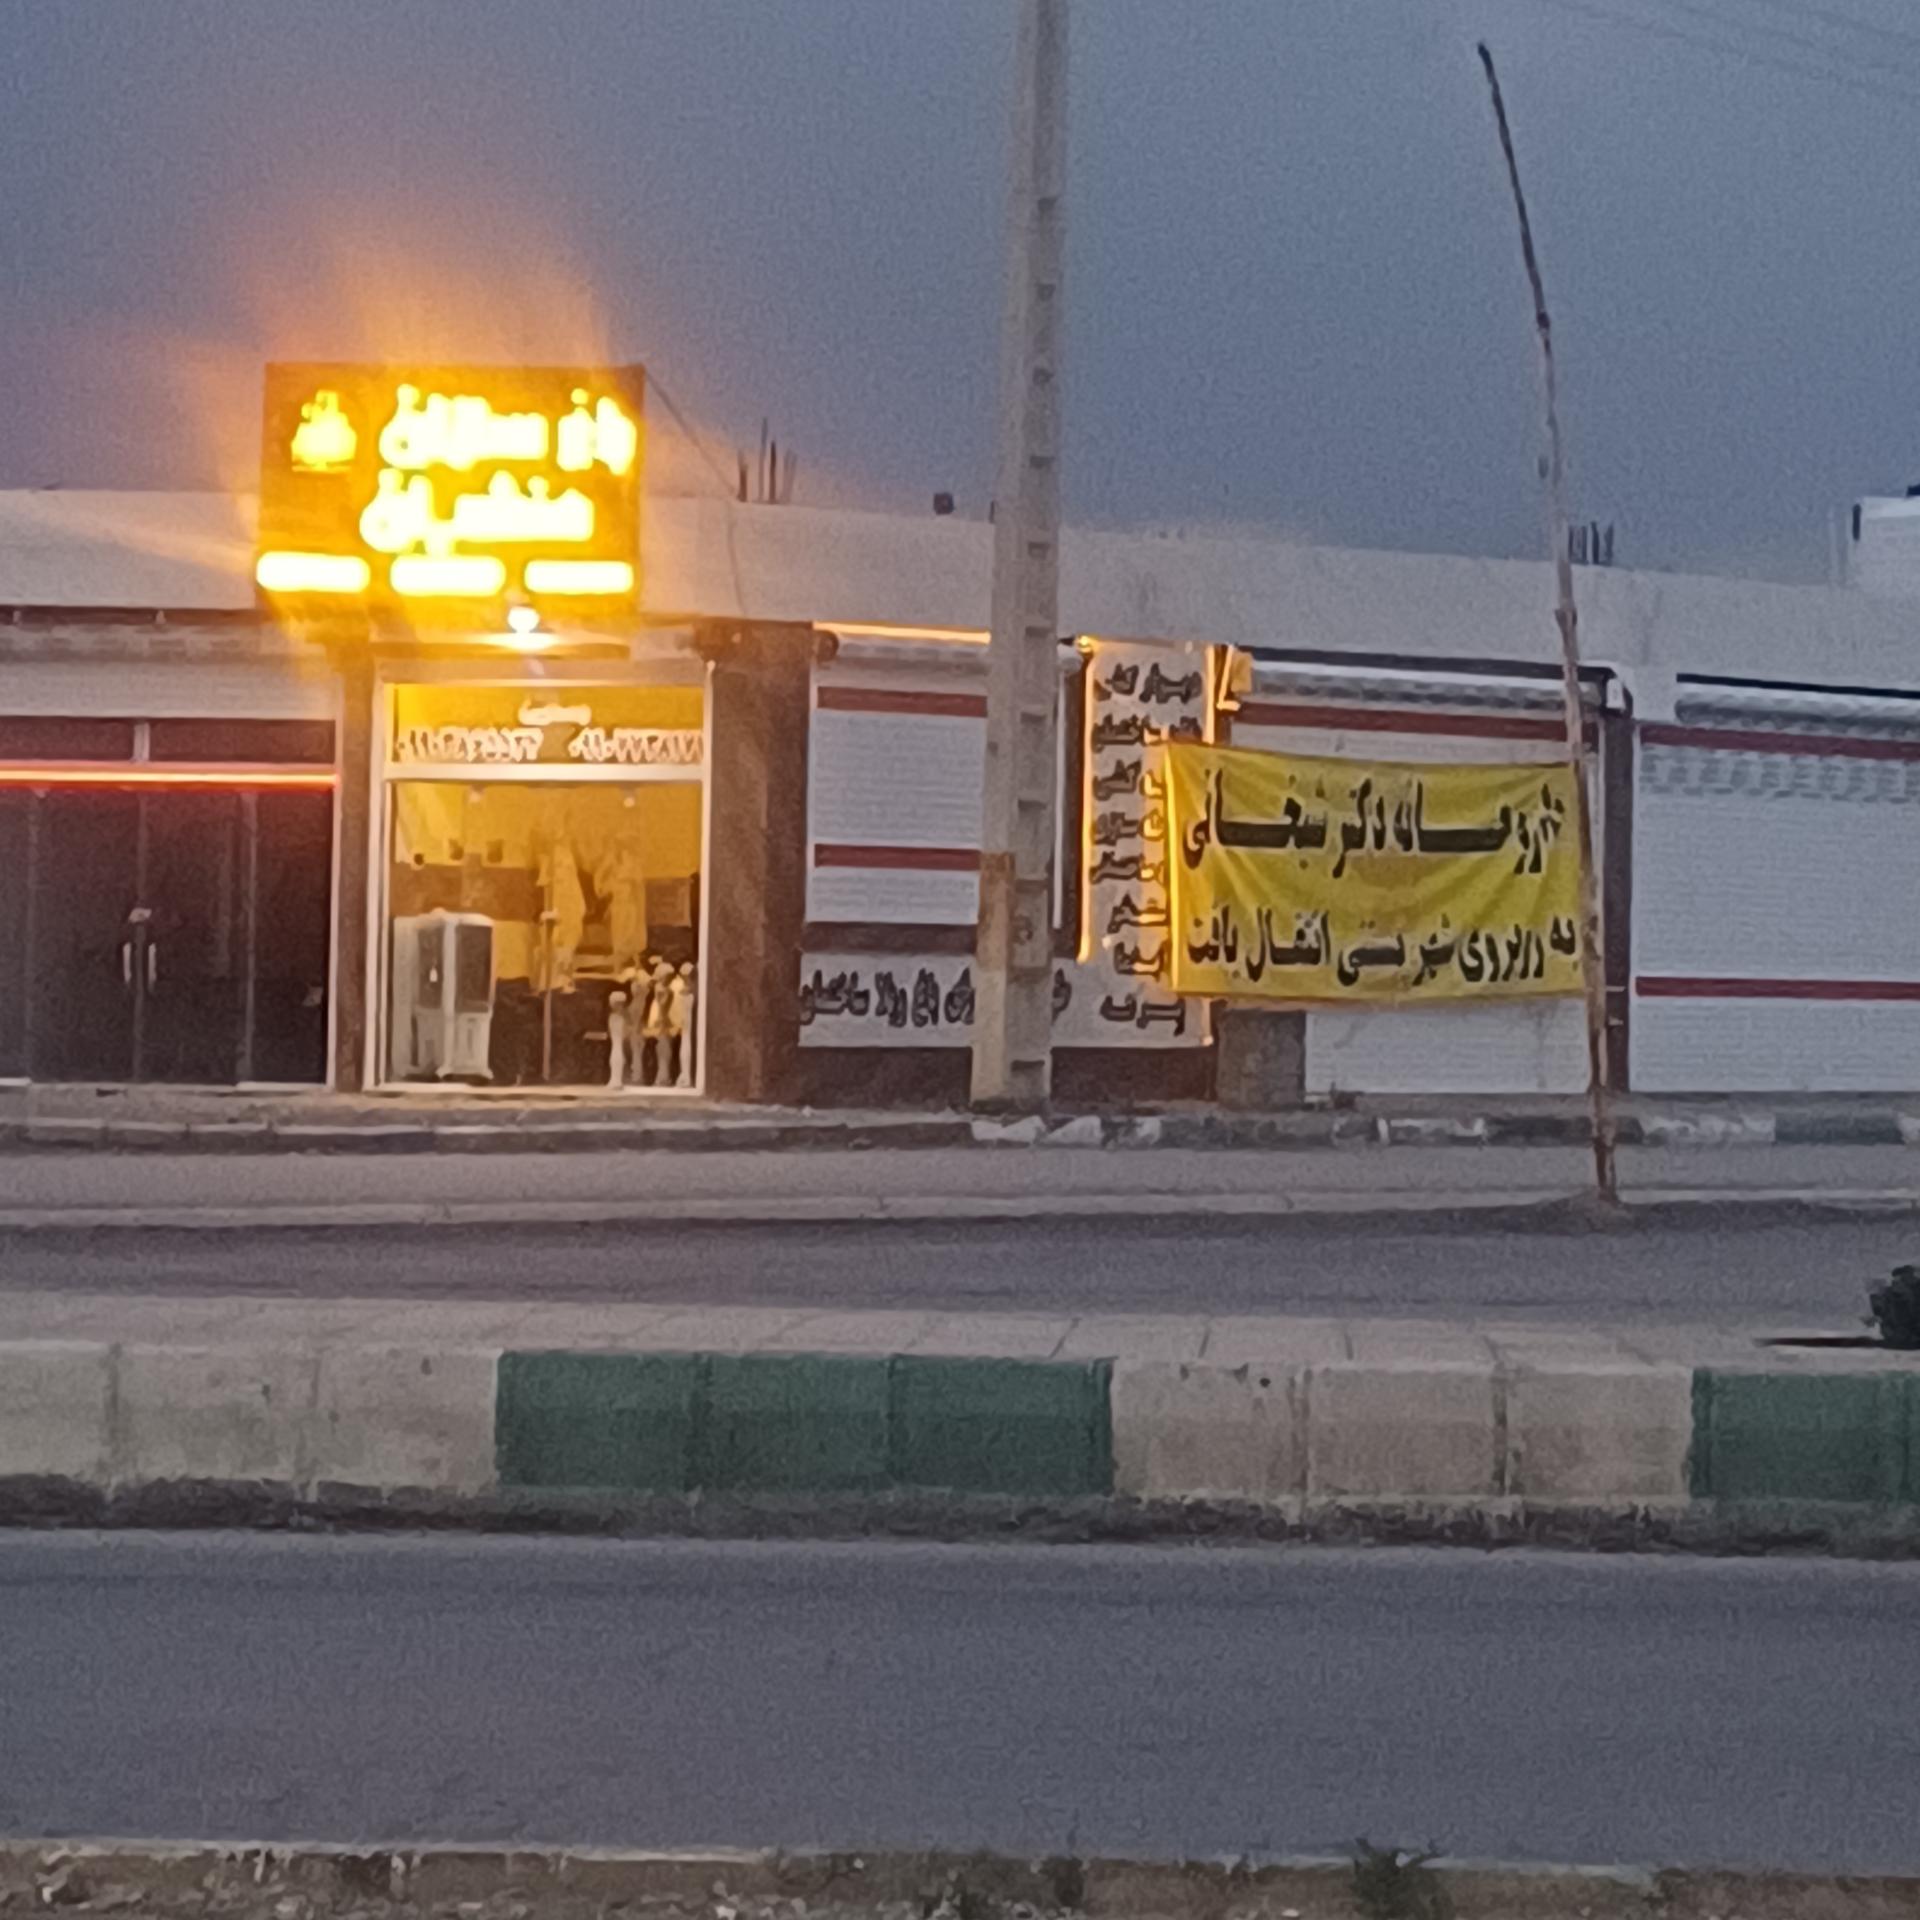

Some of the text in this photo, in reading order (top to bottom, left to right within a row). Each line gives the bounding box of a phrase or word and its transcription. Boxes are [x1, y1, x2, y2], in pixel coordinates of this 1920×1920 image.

[1332, 777, 1386, 880] دکتر
[1393, 778, 1566, 875] داروخانه
[1187, 904, 1240, 979] یافت
[1246, 907, 1331, 983] انتقال
[1459, 922, 1545, 983] روبروی
[1550, 914, 1579, 972] به
